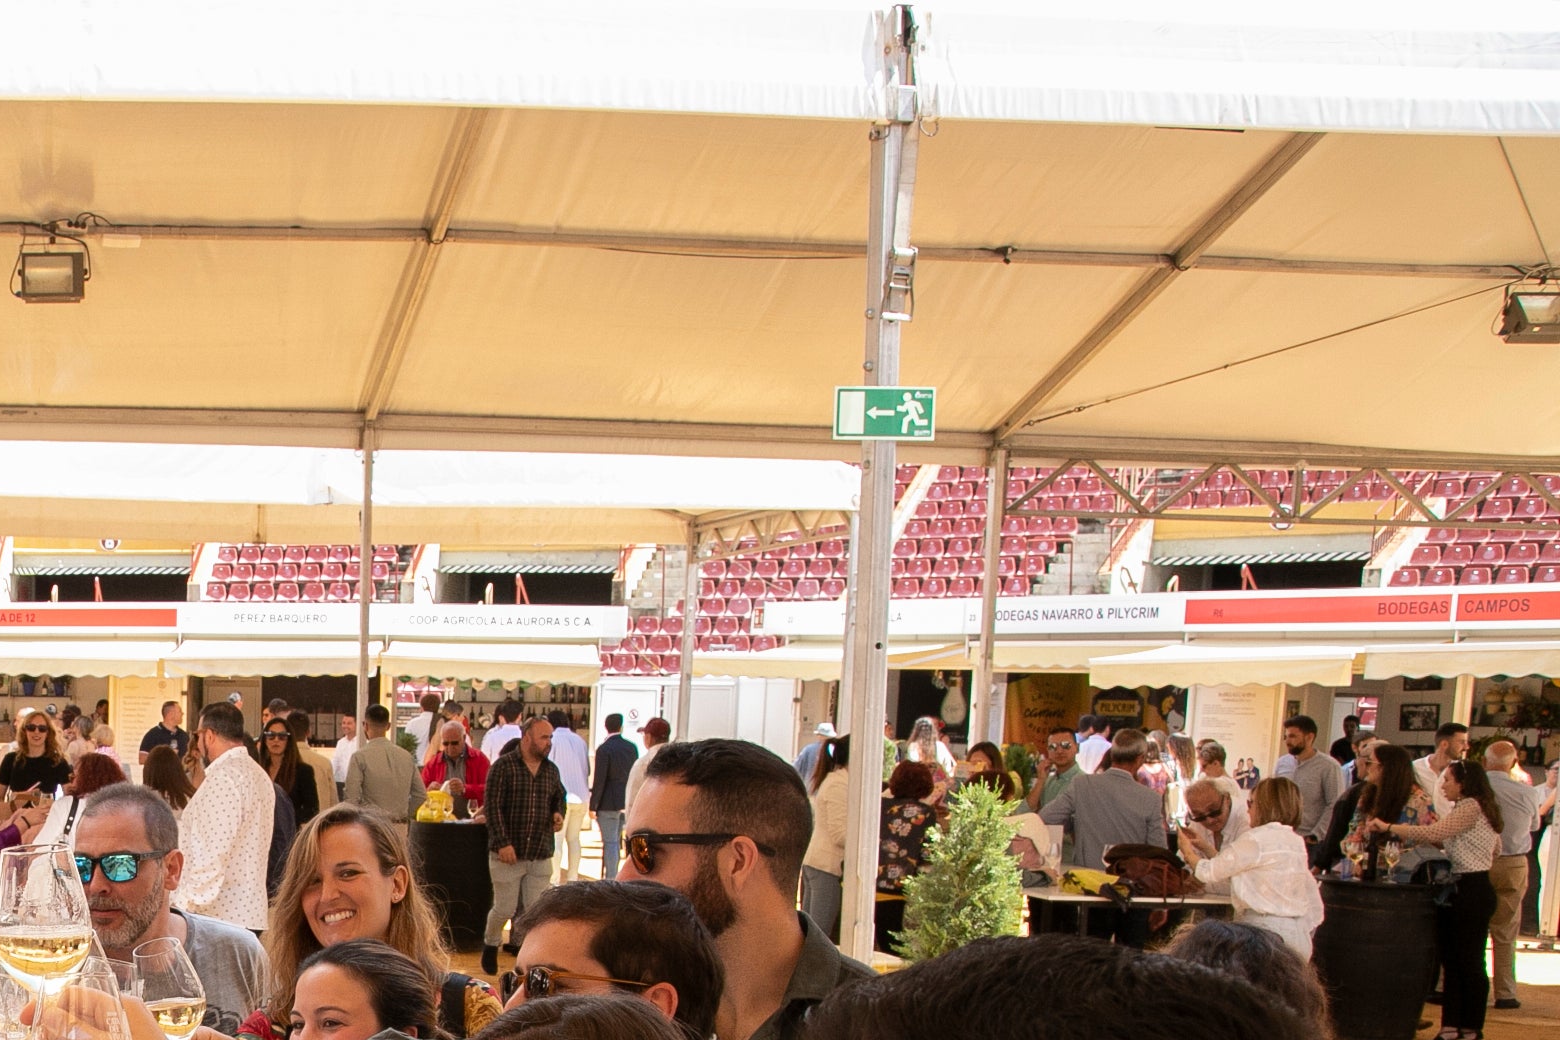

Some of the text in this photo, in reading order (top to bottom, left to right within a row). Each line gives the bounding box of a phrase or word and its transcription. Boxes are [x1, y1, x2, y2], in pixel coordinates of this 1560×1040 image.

[1377, 598, 1531, 616] BODEGAS CAMPOS
[9, 613, 23, 623] DE
[25, 613, 36, 623] 12
[233, 614, 328, 624] PEREZ BARQUERO
[995, 606, 1160, 622] ODEGAS NAVARRO & PILYCRIM
[443, 616, 497, 625] AGRICOLA
[516, 617, 561, 626] AURORA
